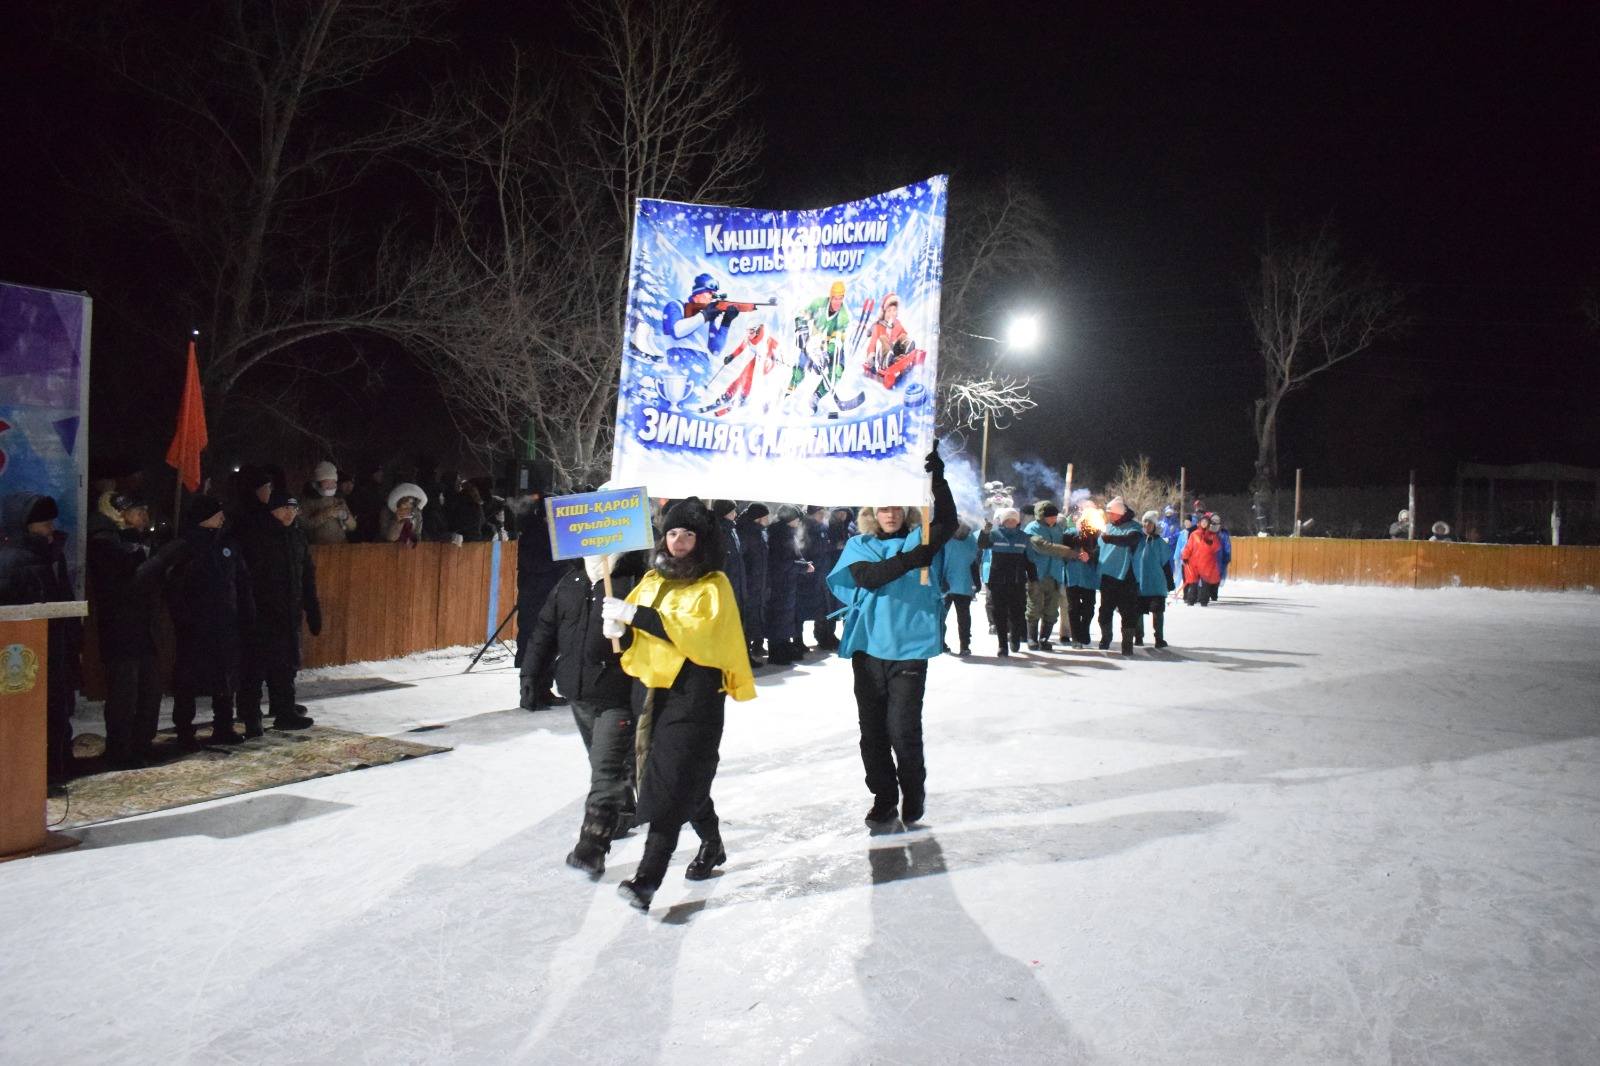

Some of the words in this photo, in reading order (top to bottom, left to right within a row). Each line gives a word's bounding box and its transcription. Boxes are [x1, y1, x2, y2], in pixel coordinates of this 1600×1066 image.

[704, 215, 888, 254] Кишикаройский
[728, 248, 817, 274] сельс
[821, 249, 865, 272] округ
[638, 408, 744, 453] ЗИМНЯЯ
[747, 410, 906, 456] СПТАКИАДА!
